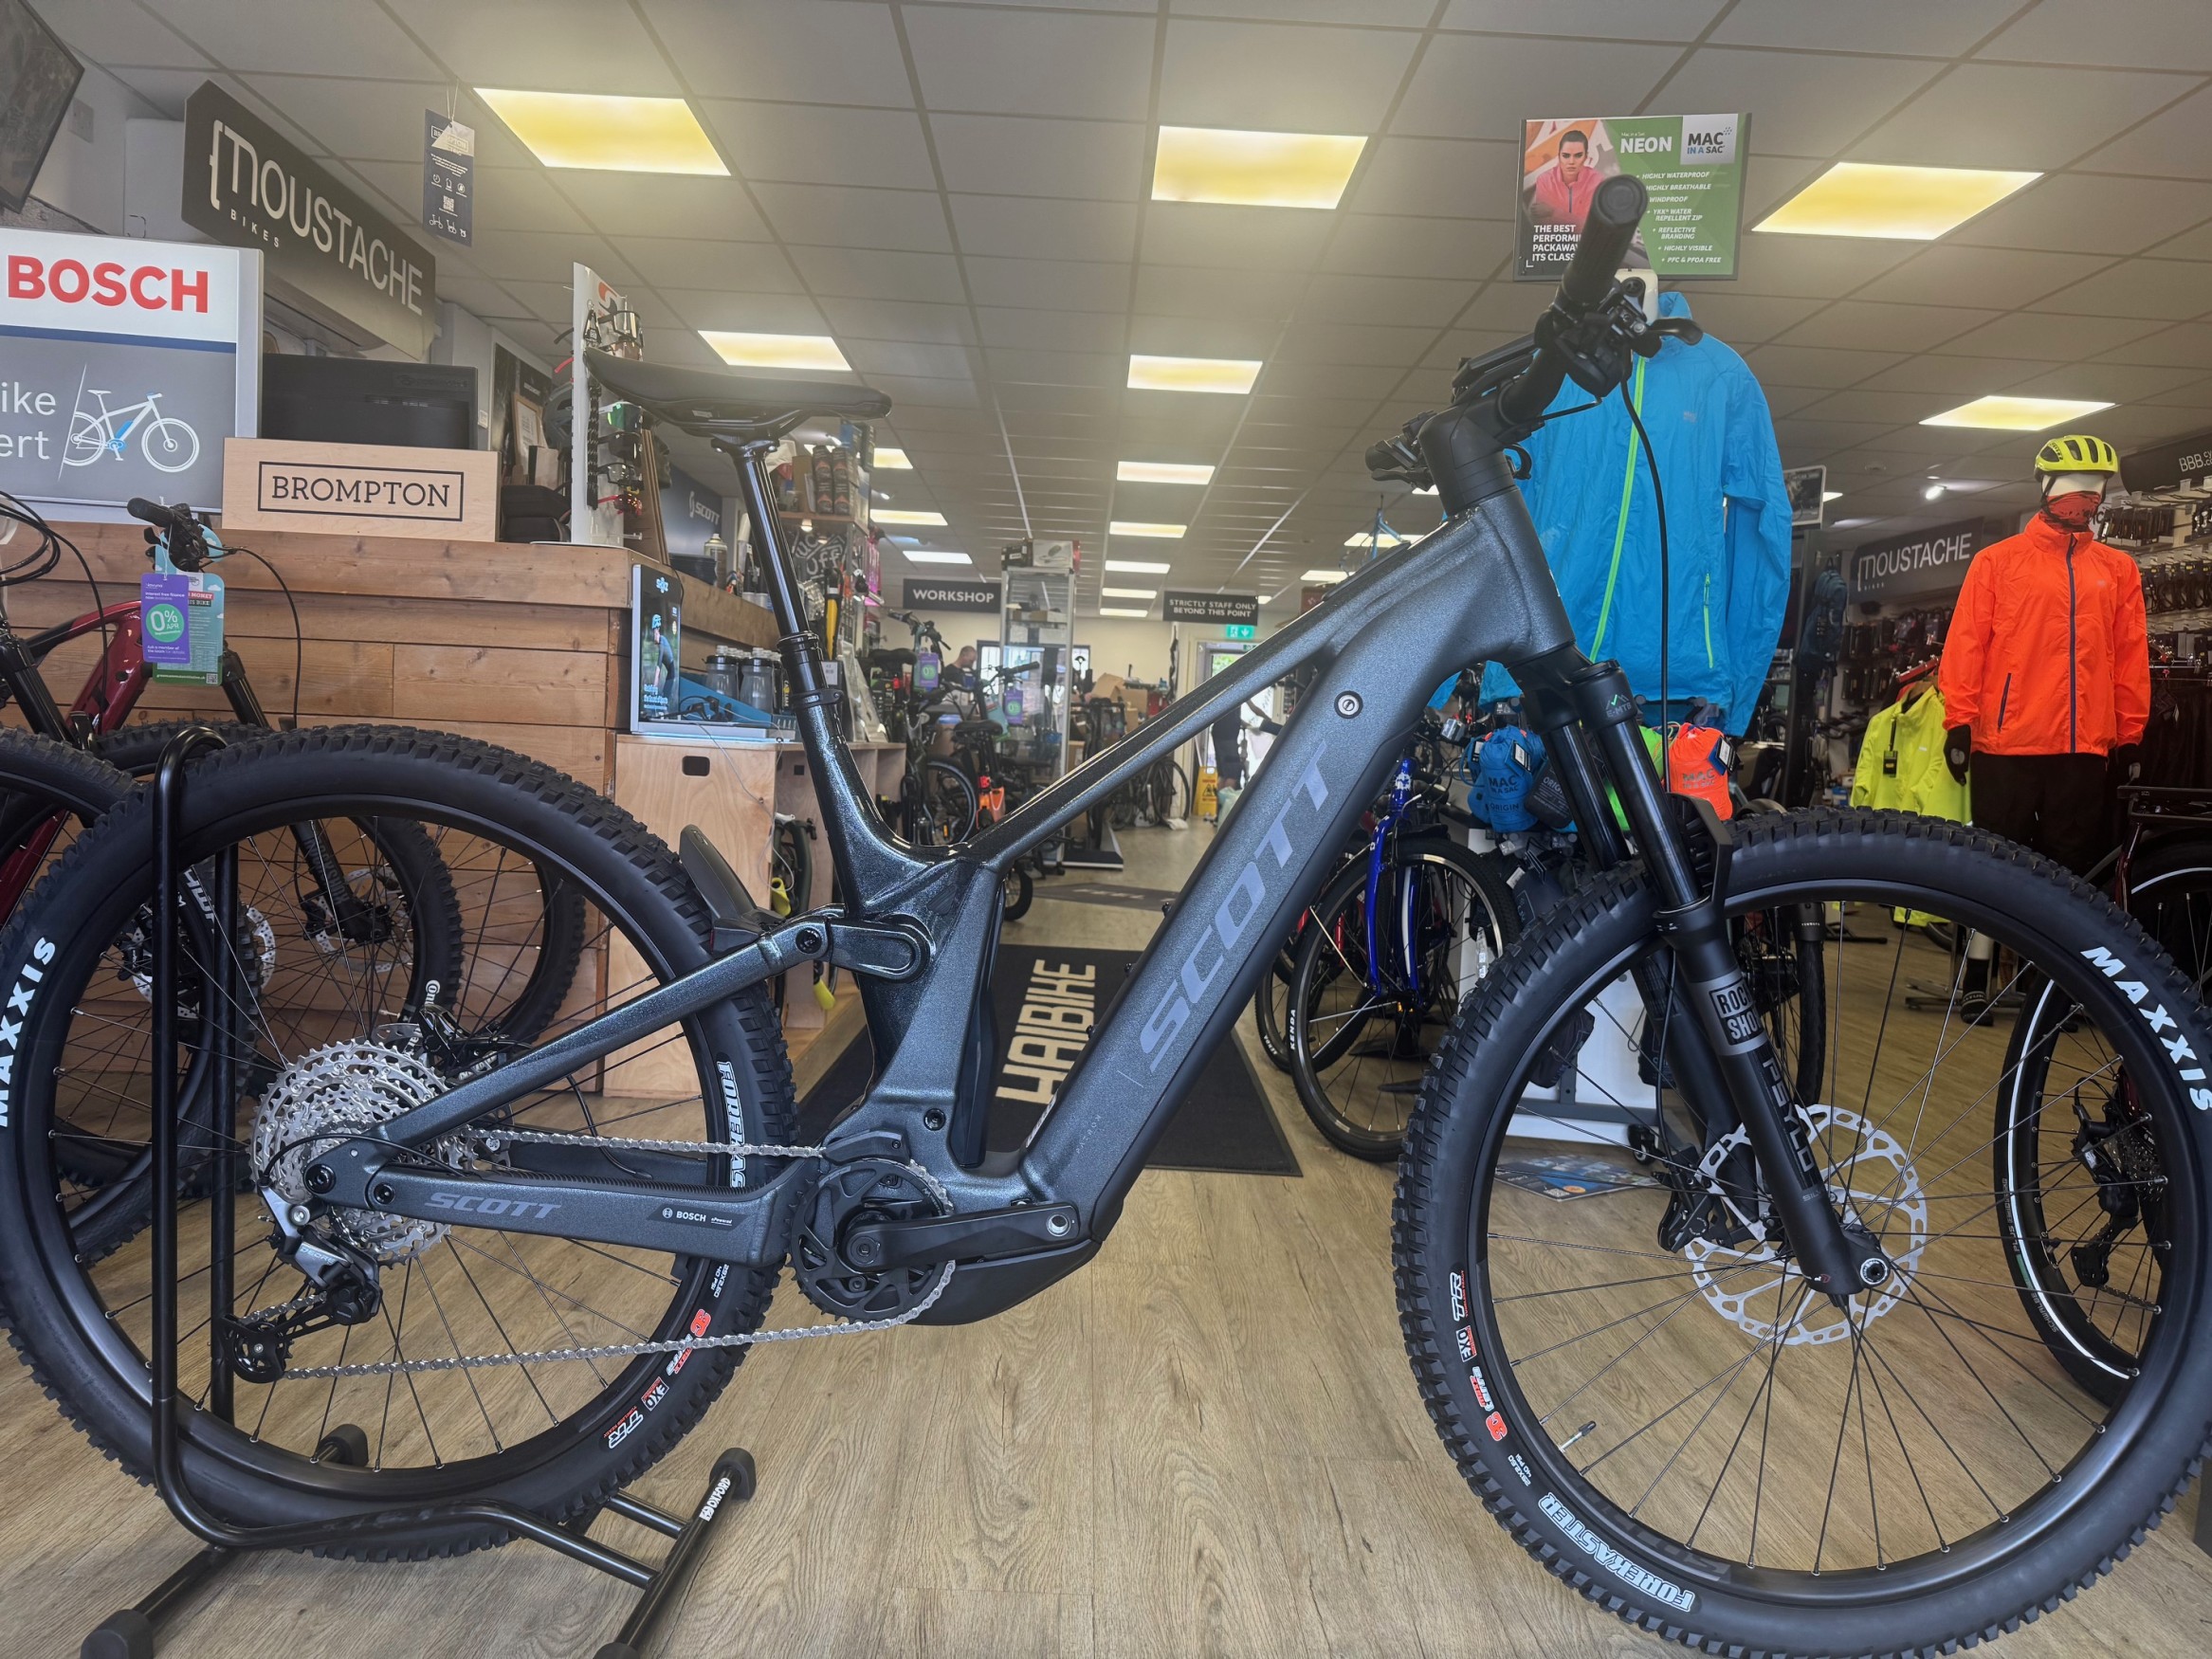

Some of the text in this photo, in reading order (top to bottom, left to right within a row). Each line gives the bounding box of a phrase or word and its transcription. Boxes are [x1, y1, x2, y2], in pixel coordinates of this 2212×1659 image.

[1620, 137, 1673, 154] NEON
[1688, 133, 1724, 146] MAC
[210, 119, 423, 316] MOUSTACHE
[230, 209, 280, 247] BIKES
[1534, 224, 1577, 233] THE BEST
[1533, 233, 1581, 243] PERFORMI
[1532, 252, 1576, 262] ITS CLASS
[8, 254, 209, 314] BOSCH
[0, 381, 57, 416] ike
[0, 430, 50, 460] ert
[272, 475, 449, 507] BROMPTON
[695, 503, 721, 525] SCOTT
[1857, 533, 1972, 592] MOUSTACHE
[912, 589, 995, 603] WORKSHOP
[151, 610, 178, 631] 0%
[1488, 775, 1517, 788] MAC
[1543, 776, 1563, 794] ORIG
[1682, 768, 1715, 782] MAC
[1139, 742, 1328, 1073] SCOTT
[996, 959, 1096, 1104] HAIBIKE
[1727, 1011, 1761, 1040] SHO
[2080, 946, 2212, 1111] MAXXIS
[1263, 1034, 1278, 1055] KENDA
[717, 1061, 746, 1188] FOREKAS
[1762, 1057, 1814, 1173] PSYLO
[424, 1192, 562, 1219] SCOTT
[676, 1211, 707, 1222] BOSCH
[301, 1247, 337, 1265] DEORE
[1450, 1272, 1466, 1322] TR
[2030, 1292, 2059, 1333] SCHWALBE
[1457, 1329, 1472, 1361] EXO
[645, 1384, 667, 1407] EXO
[609, 1410, 644, 1449] TR
[707, 1478, 731, 1508] OXFORD
[1538, 1491, 1695, 1612] FOREKASTER
